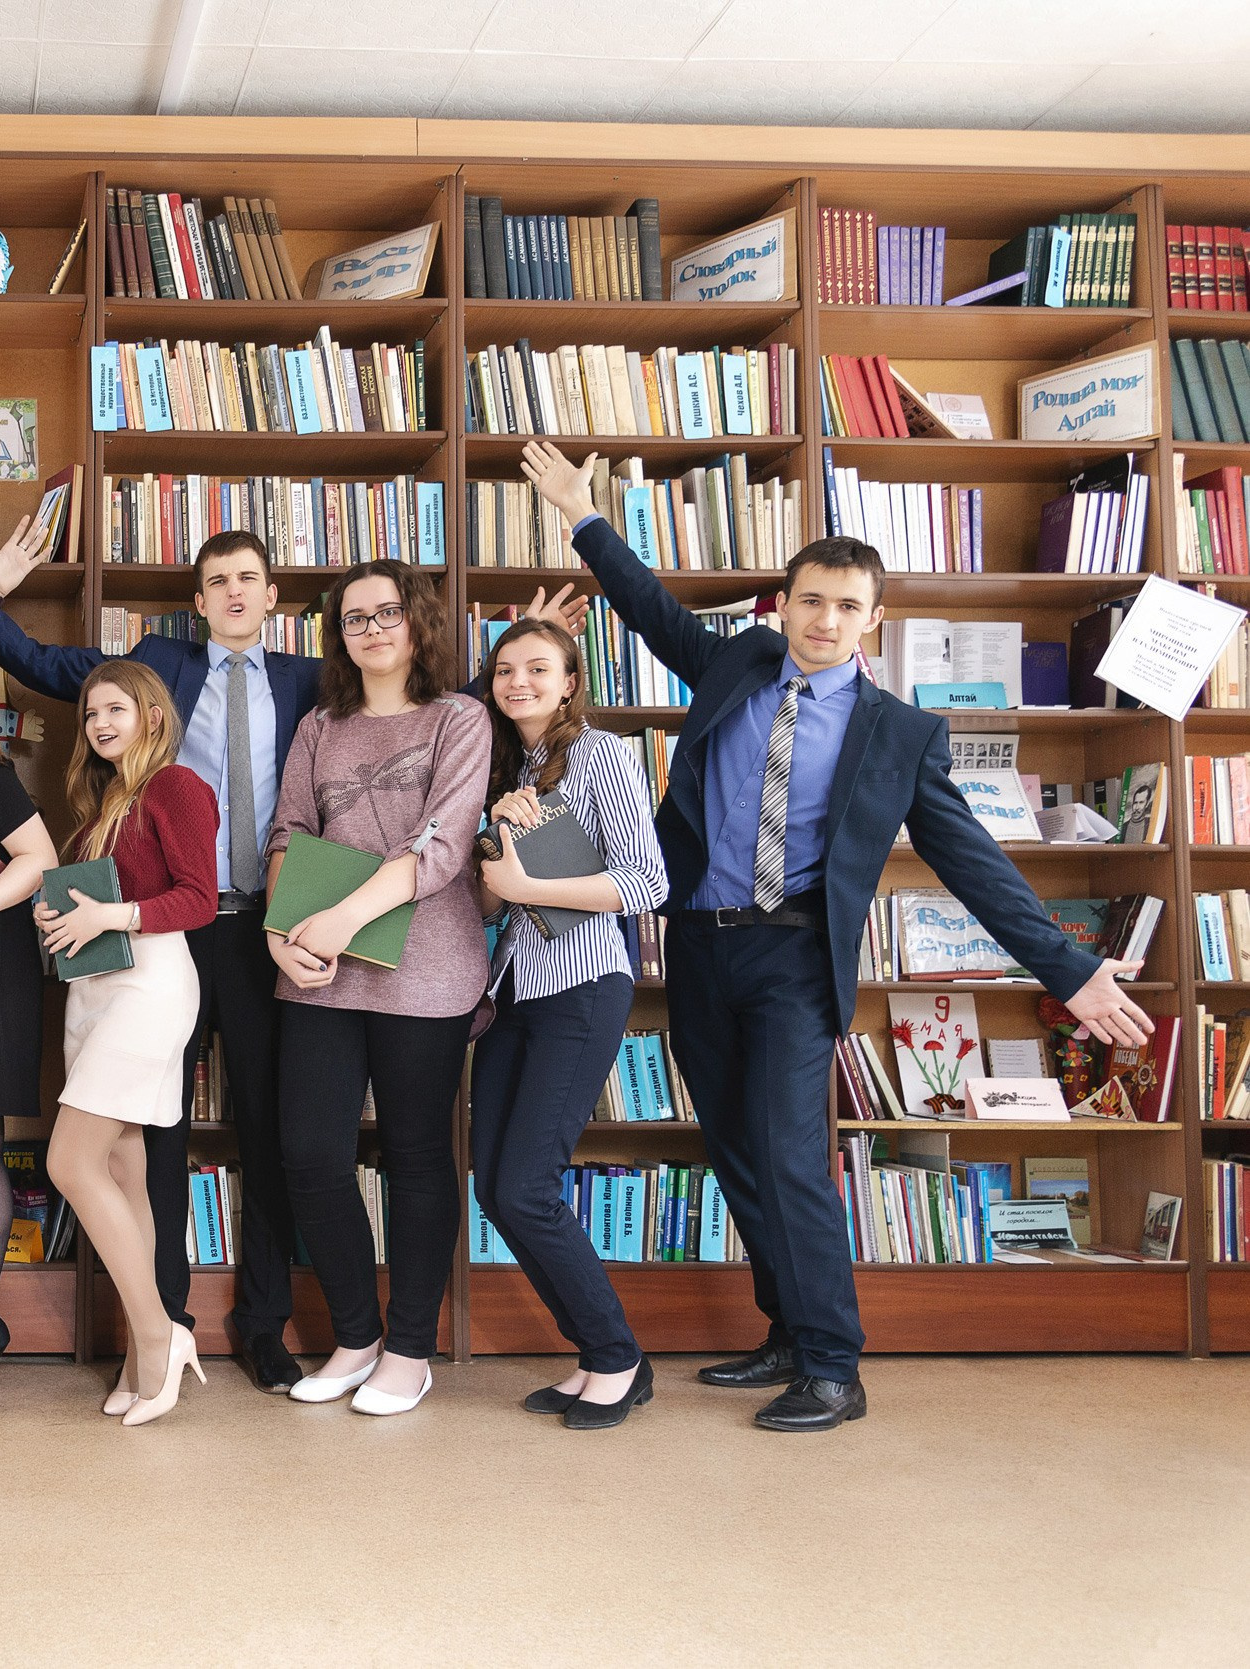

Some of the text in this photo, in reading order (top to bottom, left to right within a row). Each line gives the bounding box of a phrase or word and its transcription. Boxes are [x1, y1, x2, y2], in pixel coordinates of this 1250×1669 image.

[186, 207, 199, 241] СОВЕТСКАЯ
[332, 244, 422, 277] Весь
[679, 236, 778, 283] Словарный
[1054, 239, 1063, 272] Шукшин
[698, 270, 757, 302] уголок
[294, 356, 302, 377] России
[343, 352, 357, 389] История
[359, 365, 369, 394] РУССКАЯ
[367, 365, 376, 394] ИСТОРИЯ
[150, 398, 157, 407] 63
[153, 359, 168, 418] Исторические науки
[687, 371, 703, 427] Пушкин А.С.
[733, 373, 745, 416] Чехов А.П.
[1031, 375, 1144, 413] Родина моя
[1057, 399, 1116, 432] Алтай
[241, 484, 249, 510] РОССИИ
[433, 511, 441, 556] Экономические
[641, 550, 650, 560] 85
[949, 693, 977, 702] Алтай
[1051, 912, 1060, 923] Я
[1203, 919, 1216, 965] Стихотворения
[934, 995, 951, 1023] 9
[920, 1020, 963, 1045] МАЯ
[647, 1053, 656, 1069] П.А.
[1113, 1049, 1139, 1067] ПОБЕДЫ
[624, 1044, 643, 1119] Алтайские сказки
[202, 1179, 218, 1258] 83 Литературоведение
[602, 1177, 613, 1250] Нифонтова Юлия
[623, 1185, 635, 1238] Свинцов В.Б.
[711, 1186, 721, 1239] Сидоров В.С.
[479, 1220, 489, 1253] Коржов
